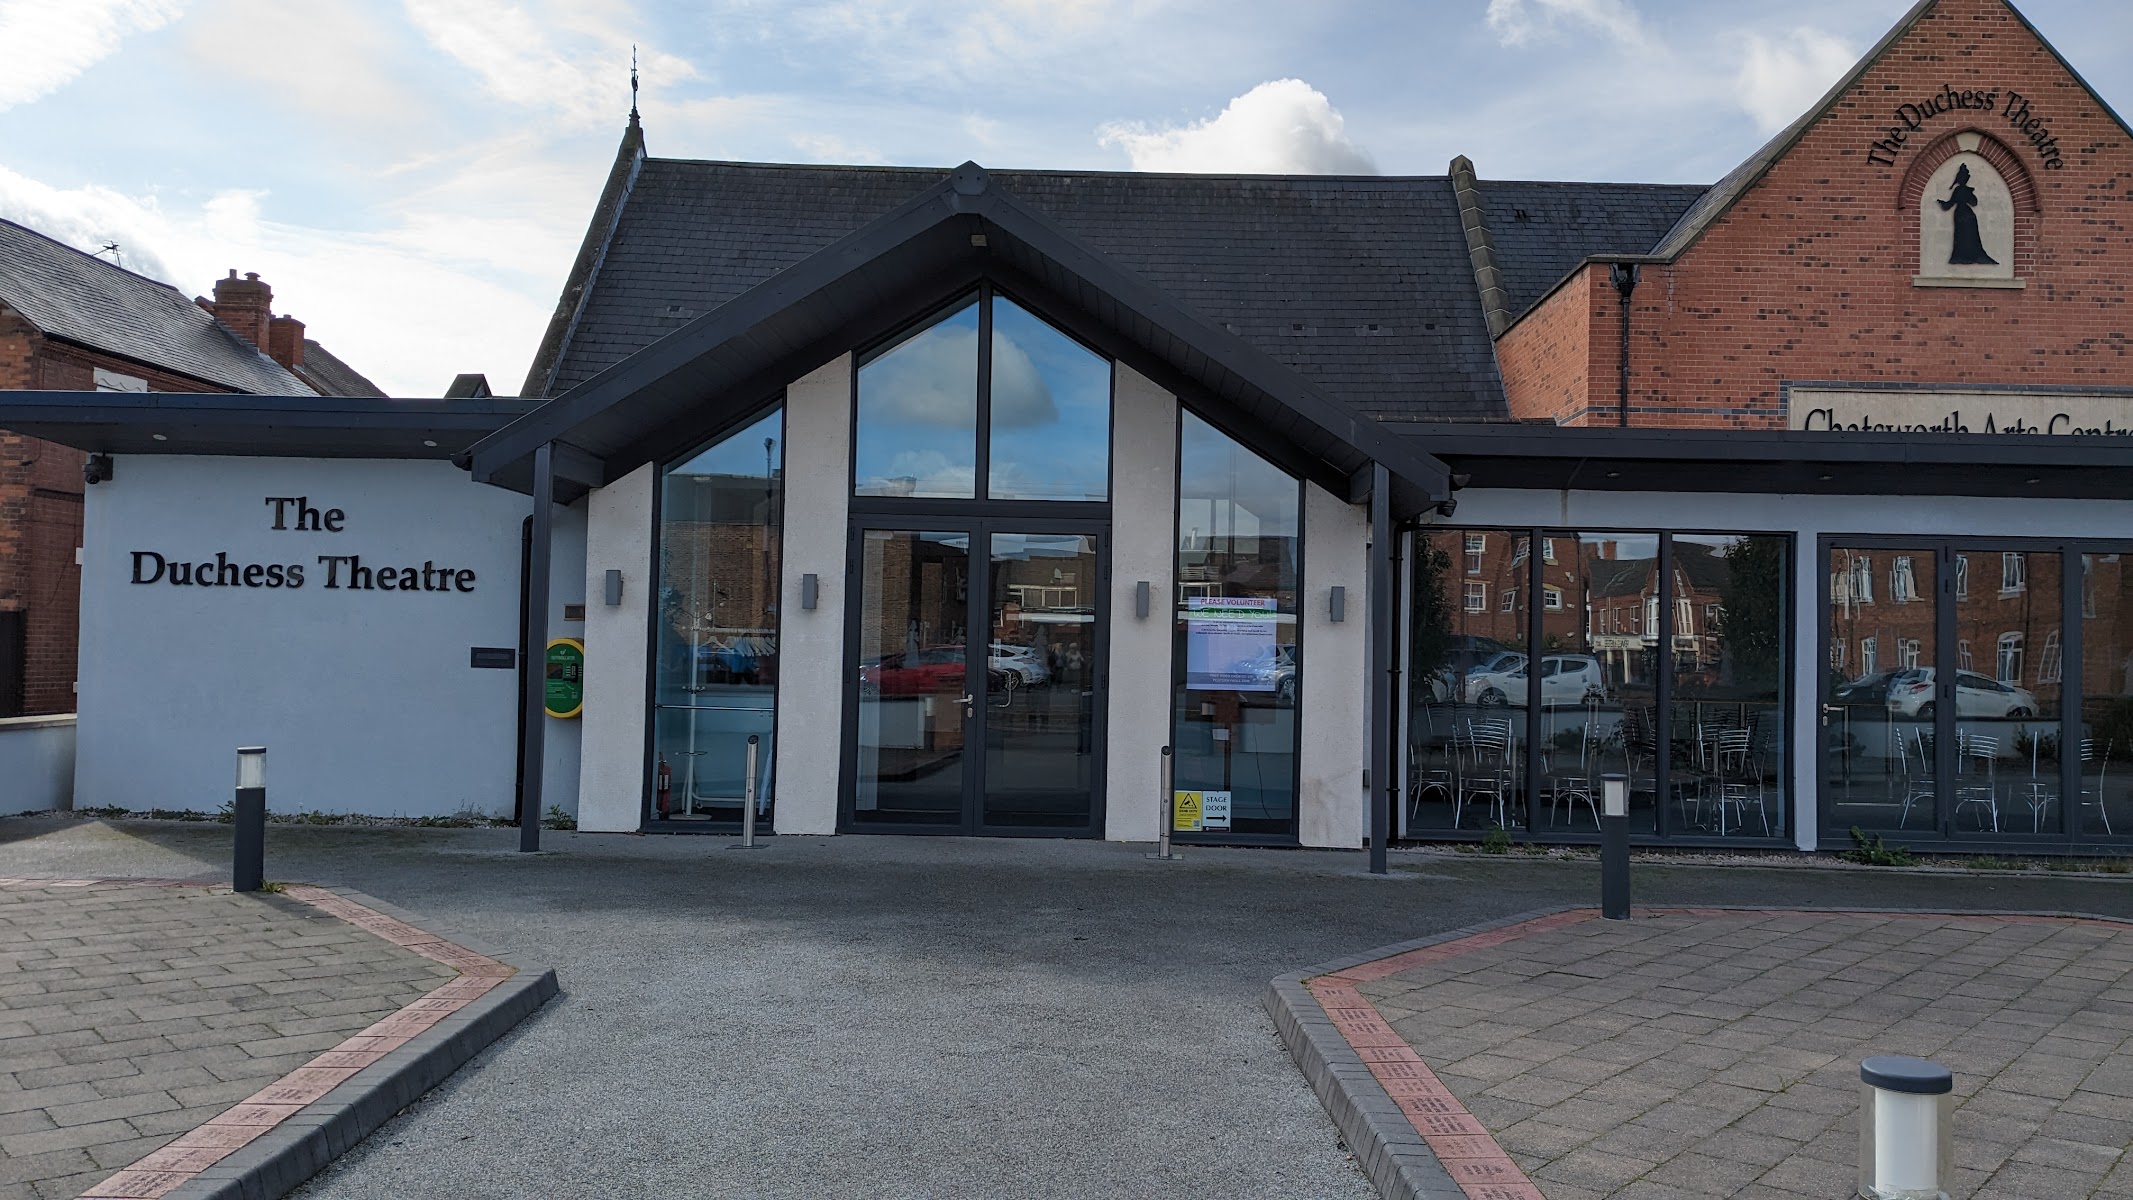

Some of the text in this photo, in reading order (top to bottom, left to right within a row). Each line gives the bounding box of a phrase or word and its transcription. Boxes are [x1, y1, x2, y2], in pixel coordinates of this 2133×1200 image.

[1866, 83, 2064, 170] The Duchess Theatre
[265, 496, 345, 532] The
[130, 551, 476, 592] Duchess Theatre
[1193, 608, 1210, 618] WE
[1214, 609, 1244, 619] NEED
